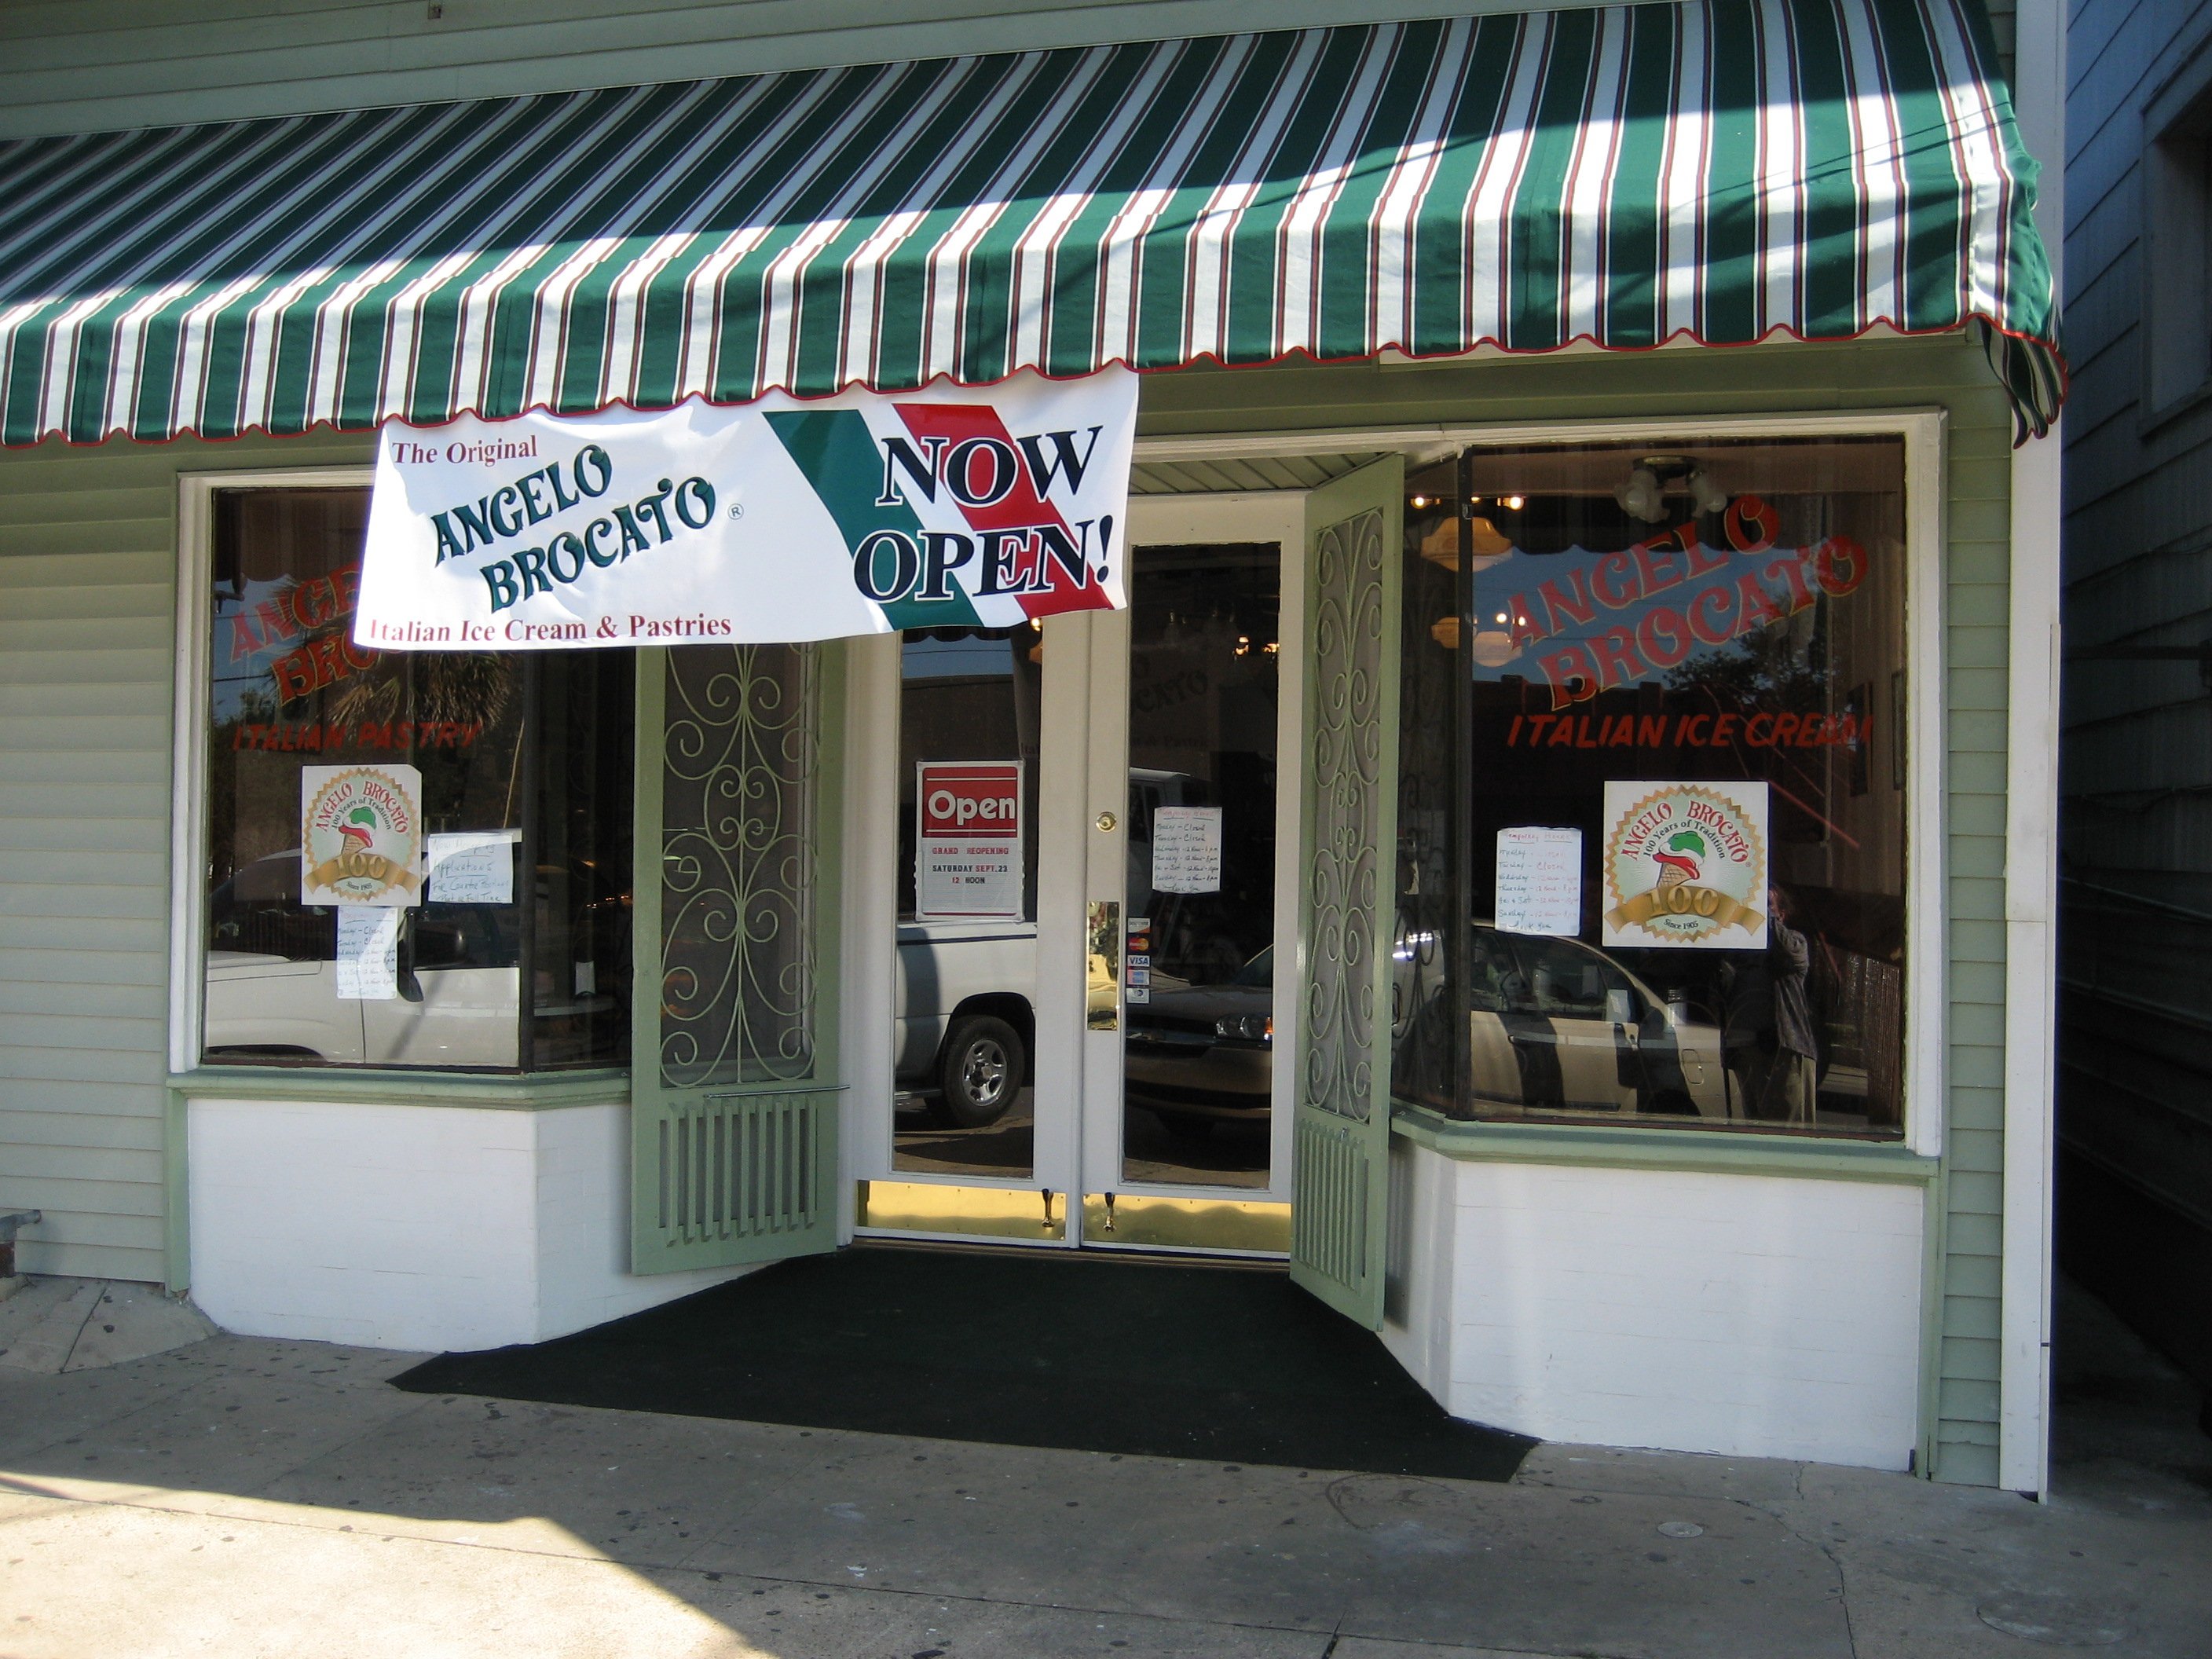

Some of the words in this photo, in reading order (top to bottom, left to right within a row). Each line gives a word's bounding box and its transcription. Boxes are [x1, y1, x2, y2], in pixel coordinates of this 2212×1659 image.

[392, 441, 438, 464] The
[446, 435, 538, 468] Original
[875, 425, 1104, 507] NOW
[430, 443, 613, 568] ANGELO
[479, 475, 716, 614] BROCATO
[853, 515, 1114, 602] OPEN!
[1507, 494, 1781, 651] ANGELO
[231, 560, 361, 664] ANGE
[370, 618, 451, 643] Italian
[460, 619, 496, 642] Ice
[505, 618, 587, 642] Cream
[595, 615, 618, 639] &
[629, 613, 732, 638] Pastries
[1536, 535, 1869, 712] BROCATO
[232, 723, 347, 753] ITALIAN
[358, 720, 482, 751] PASTRY
[1507, 714, 1666, 749] ITALIAN
[1673, 713, 1741, 748] ICE
[1744, 712, 1875, 749] CREAM
[315, 782, 353, 833] ANGELO
[362, 780, 410, 833] BROCATO
[331, 815, 341, 830] 100
[339, 800, 357, 815] Years
[358, 797, 367, 805] of
[368, 798, 392, 830] Tradition
[928, 789, 1016, 826] Open
[1621, 802, 1672, 861] ANGELO
[1686, 800, 1750, 863] BROCATO
[1643, 840, 1656, 858] 100
[1654, 822, 1679, 840] Years
[1680, 819, 1691, 828] of
[1694, 821, 1727, 859] Tradition
[335, 853, 387, 879] 100
[346, 881, 360, 891] Since
[1646, 885, 1720, 917] 100
[1663, 917, 1682, 931] Since
[1683, 920, 1700, 931] 1905
[1130, 957, 1148, 965] VISA
